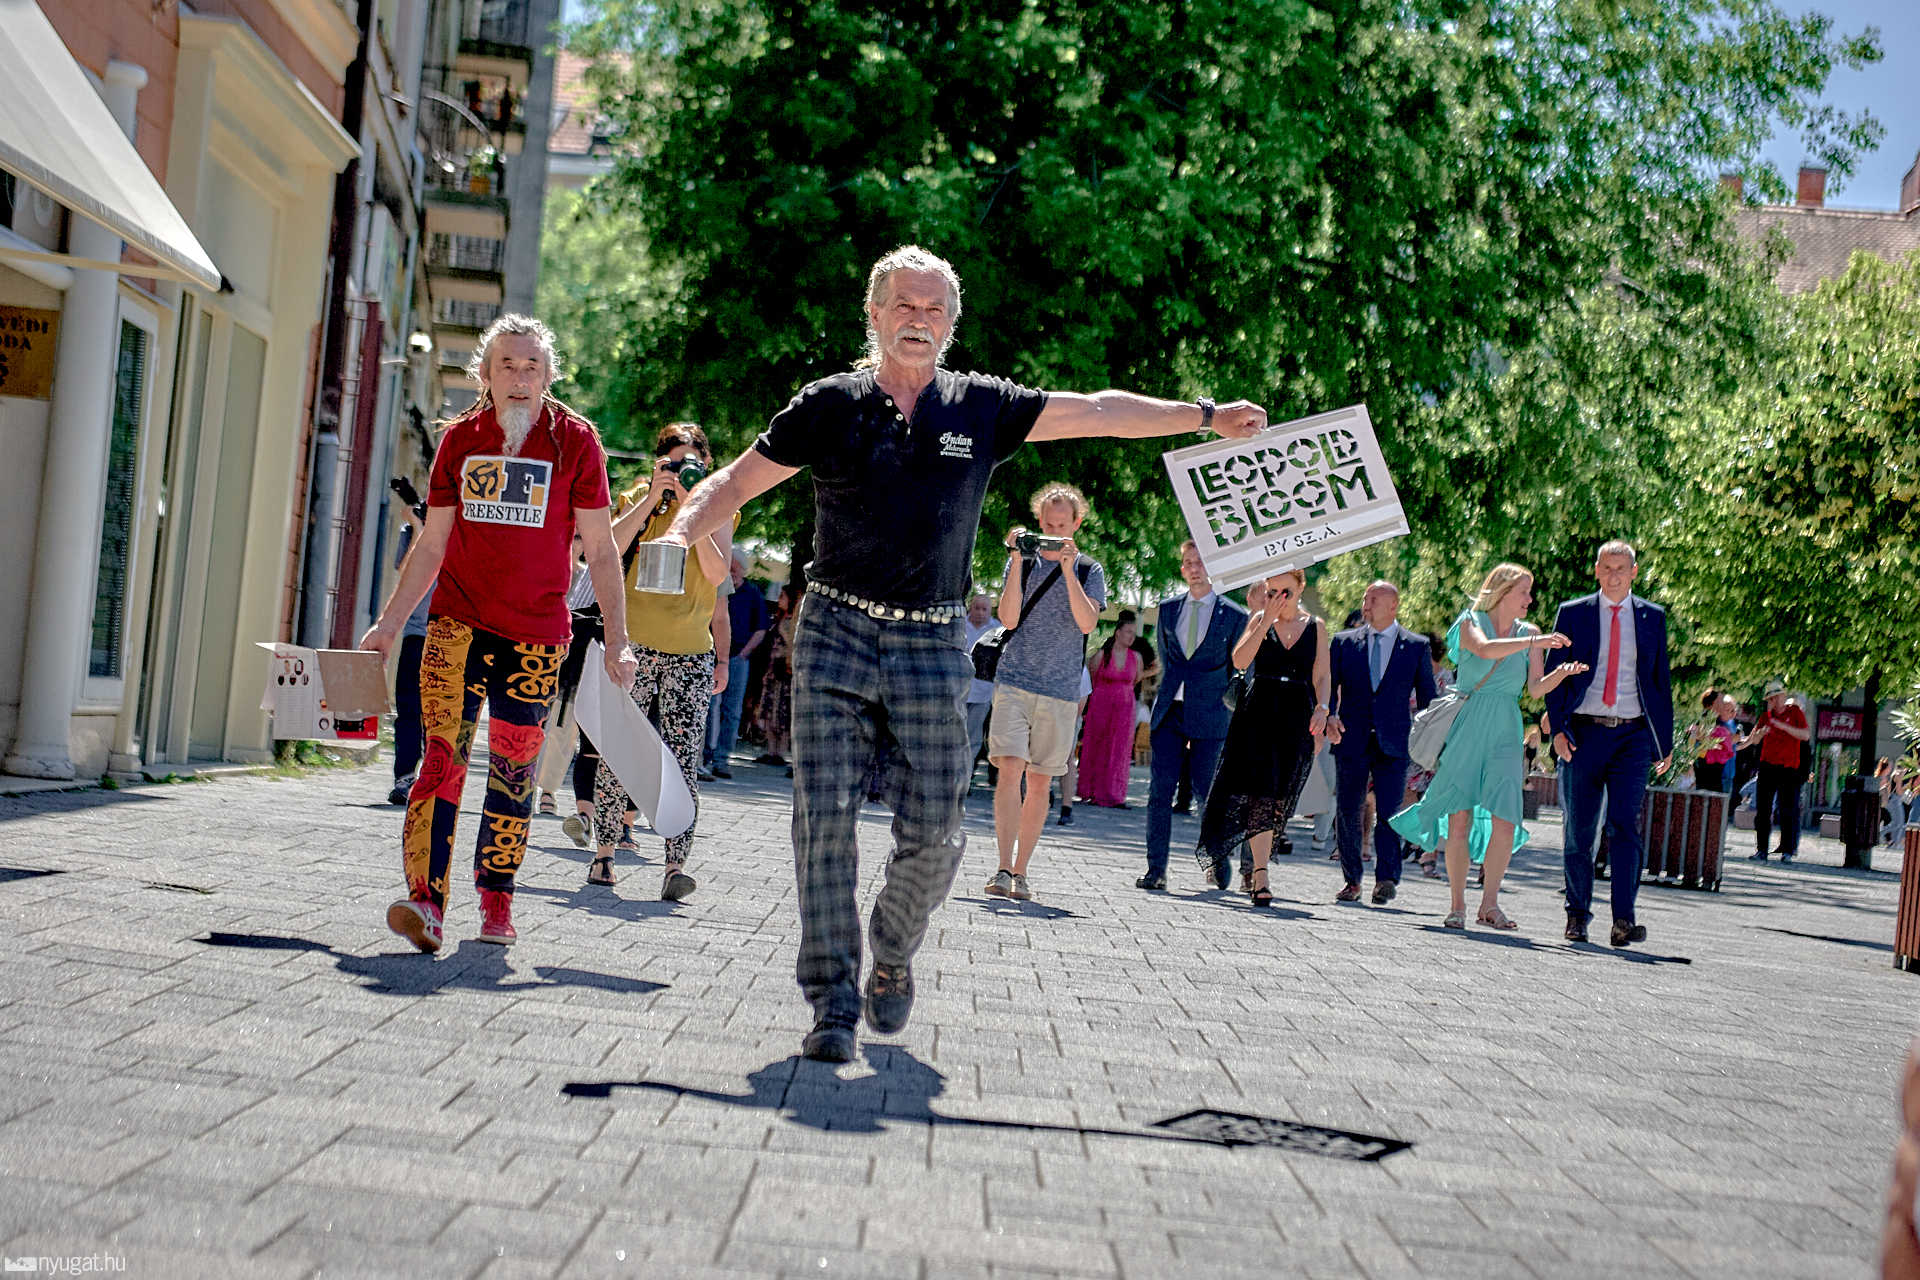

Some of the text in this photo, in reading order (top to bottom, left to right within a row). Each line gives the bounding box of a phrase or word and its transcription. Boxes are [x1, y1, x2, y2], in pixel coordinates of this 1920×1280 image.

[939, 431, 974, 446] Indian
[1188, 429, 1363, 506] LEOPOLD
[1204, 465, 1378, 548] BLOOM
[1264, 538, 1288, 557] BY
